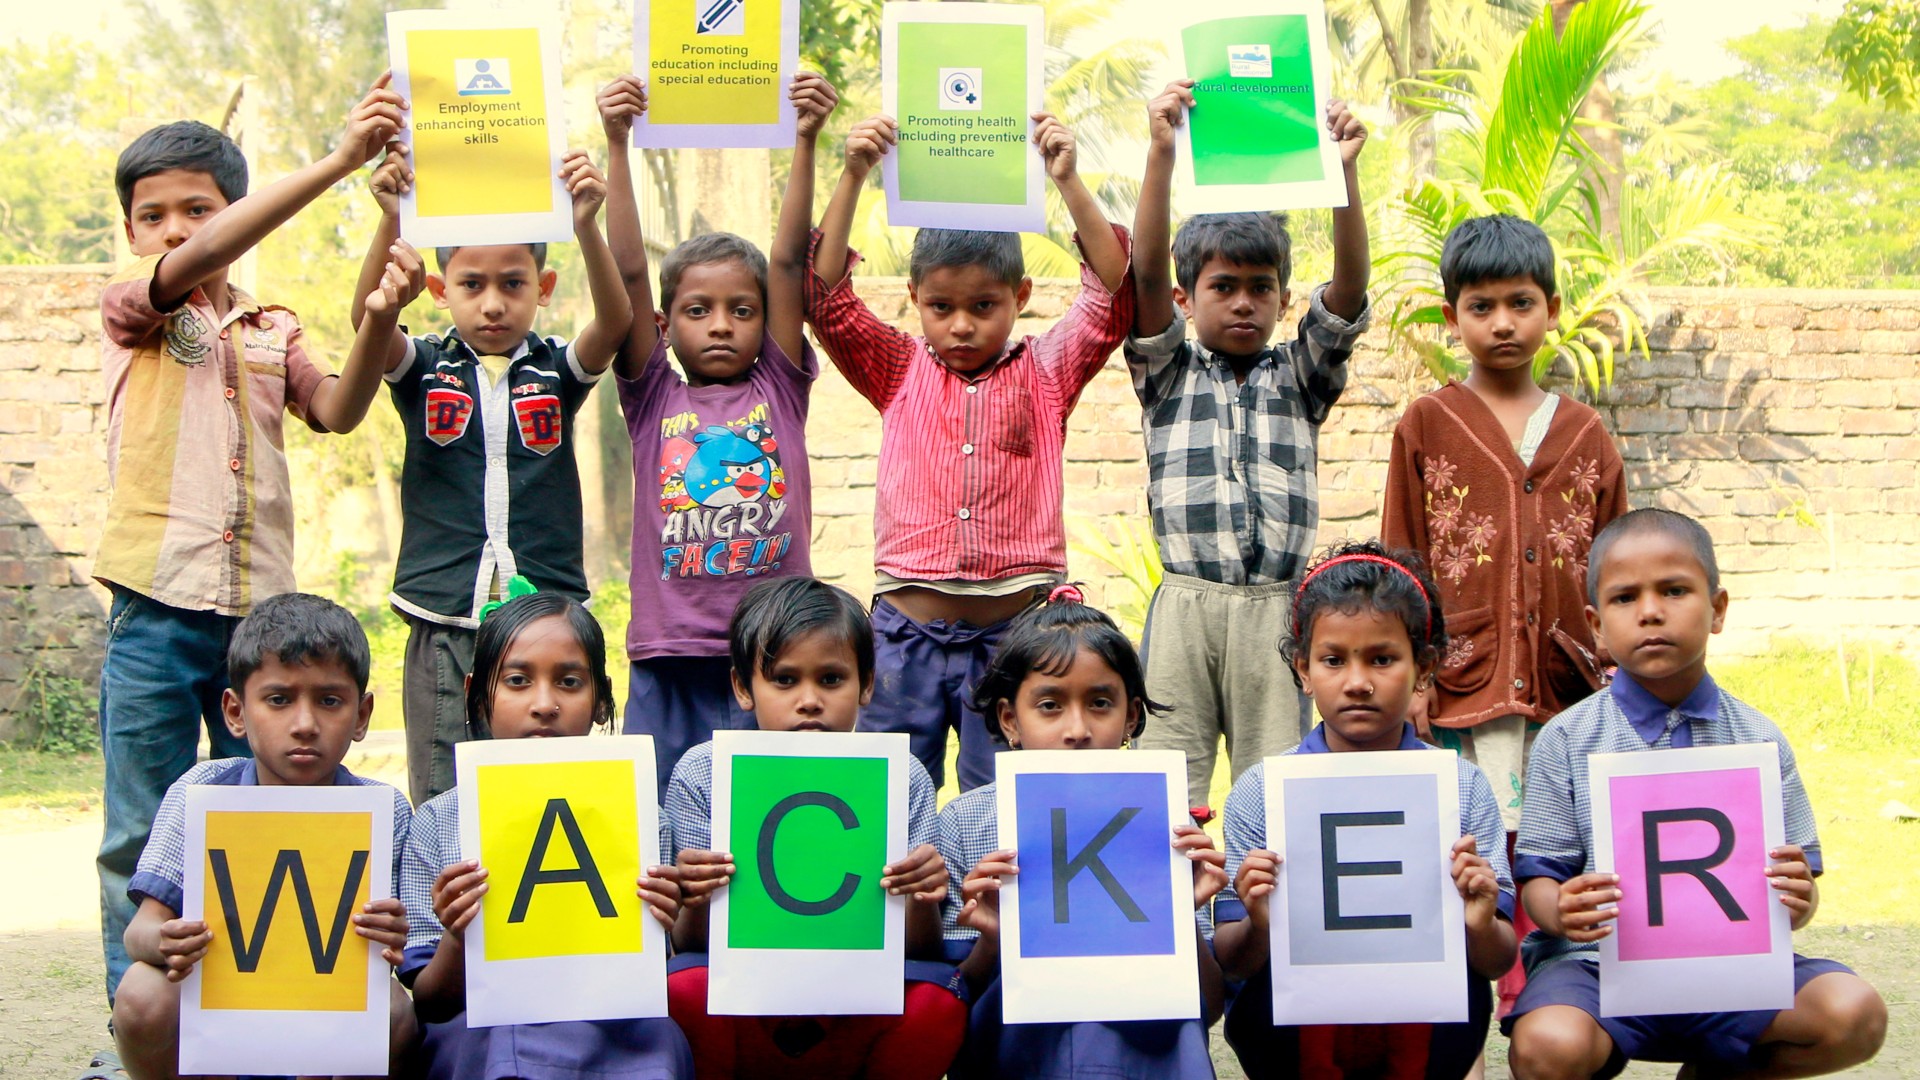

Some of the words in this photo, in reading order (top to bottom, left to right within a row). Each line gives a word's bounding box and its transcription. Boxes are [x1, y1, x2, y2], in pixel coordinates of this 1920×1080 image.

[682, 44, 748, 57] Promoting
[652, 58, 715, 71] education
[718, 59, 778, 73] including
[658, 74, 704, 87] special
[707, 74, 771, 86] education
[1194, 82, 1226, 93] Rural
[1230, 83, 1309, 95] development
[438, 101, 521, 115] Employment
[415, 117, 485, 132] enhancing
[489, 115, 545, 129] vocation
[907, 115, 974, 129] Promoting
[977, 116, 1017, 128] health
[464, 132, 499, 145] skills
[898, 130, 956, 144] including
[960, 131, 1027, 145] preventive
[929, 146, 995, 158] healthcare
[660, 410, 699, 441] THIS
[660, 500, 788, 545] ANGRY
[661, 531, 792, 581] FACE!!!
[507, 798, 618, 924] A
[756, 791, 861, 916] C
[1050, 807, 1150, 924] K
[1320, 811, 1412, 930] E
[1641, 807, 1750, 927] R
[208, 849, 370, 975] W
